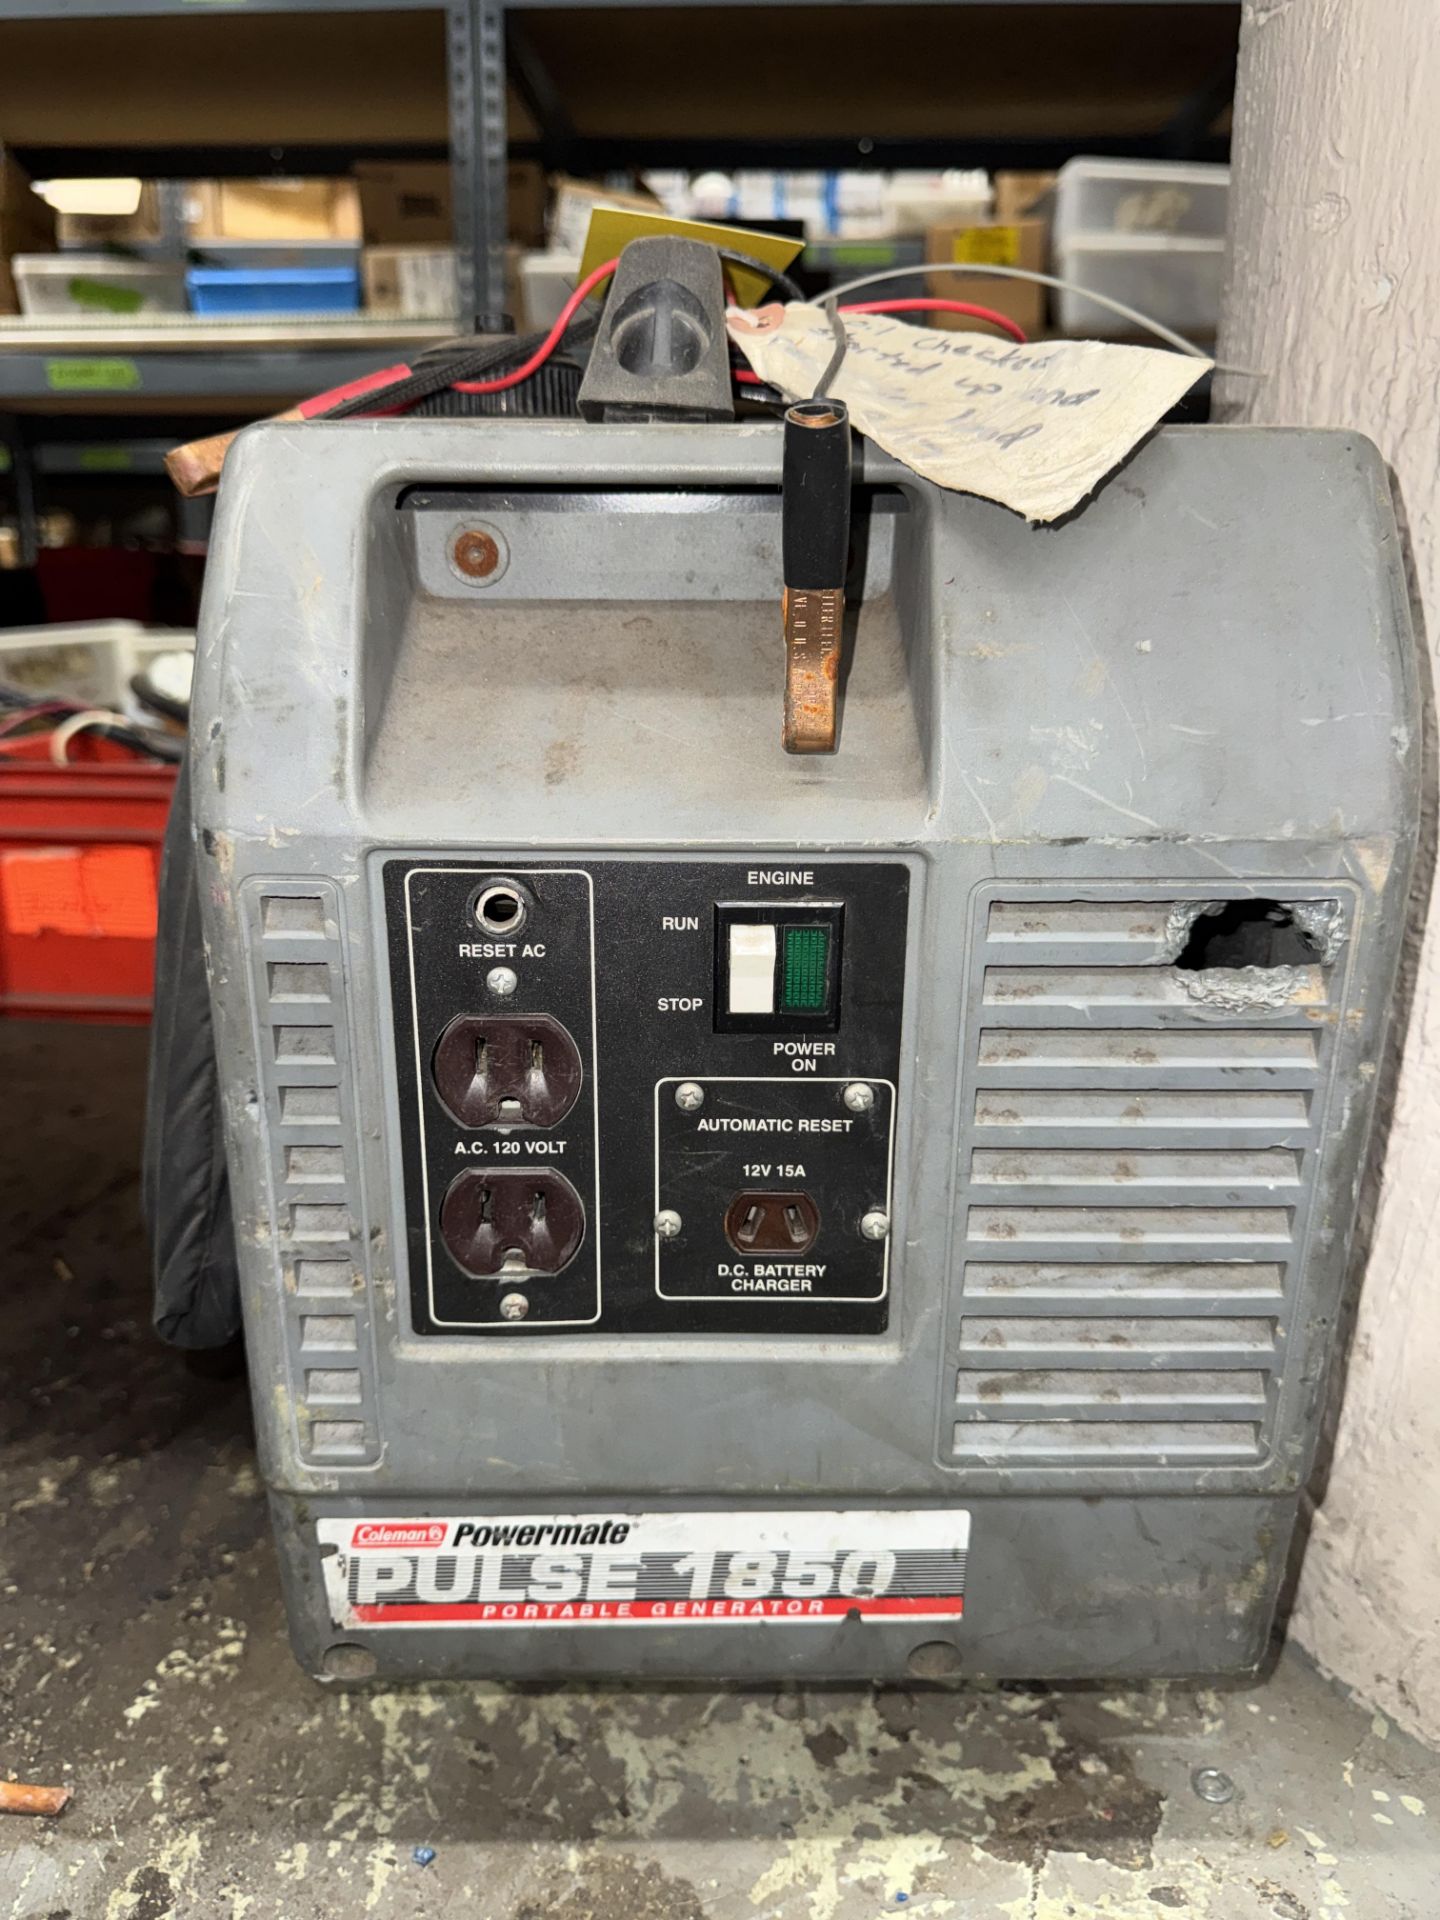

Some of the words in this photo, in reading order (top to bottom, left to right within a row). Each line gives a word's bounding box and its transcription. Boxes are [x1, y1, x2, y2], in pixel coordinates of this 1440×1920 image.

[747, 870, 815, 886] ENGINE
[662, 916, 699, 931] RUN
[458, 943, 517, 958] RESET
[521, 943, 546, 958] AC
[657, 997, 703, 1012] STOP
[773, 1042, 836, 1057] POWER
[791, 1058, 817, 1073] ON
[697, 1118, 793, 1132] AUTOMATIC
[798, 1118, 854, 1133] RESET
[454, 1141, 488, 1155] A.C.
[492, 1141, 521, 1155] 120
[524, 1140, 567, 1154] VOLT
[742, 1164, 772, 1177] 12V
[776, 1164, 806, 1177] 15A
[717, 1263, 749, 1277] D.C.
[753, 1263, 827, 1278] BATTERY
[730, 1279, 813, 1293] CHARGER
[357, 1525, 426, 1544] Coleman
[452, 1519, 631, 1548] Powermate
[356, 1554, 644, 1604] PULSE
[673, 1548, 898, 1600] 1850
[482, 1602, 632, 1619] PORTABLE
[650, 1600, 825, 1617] GENERATOR
